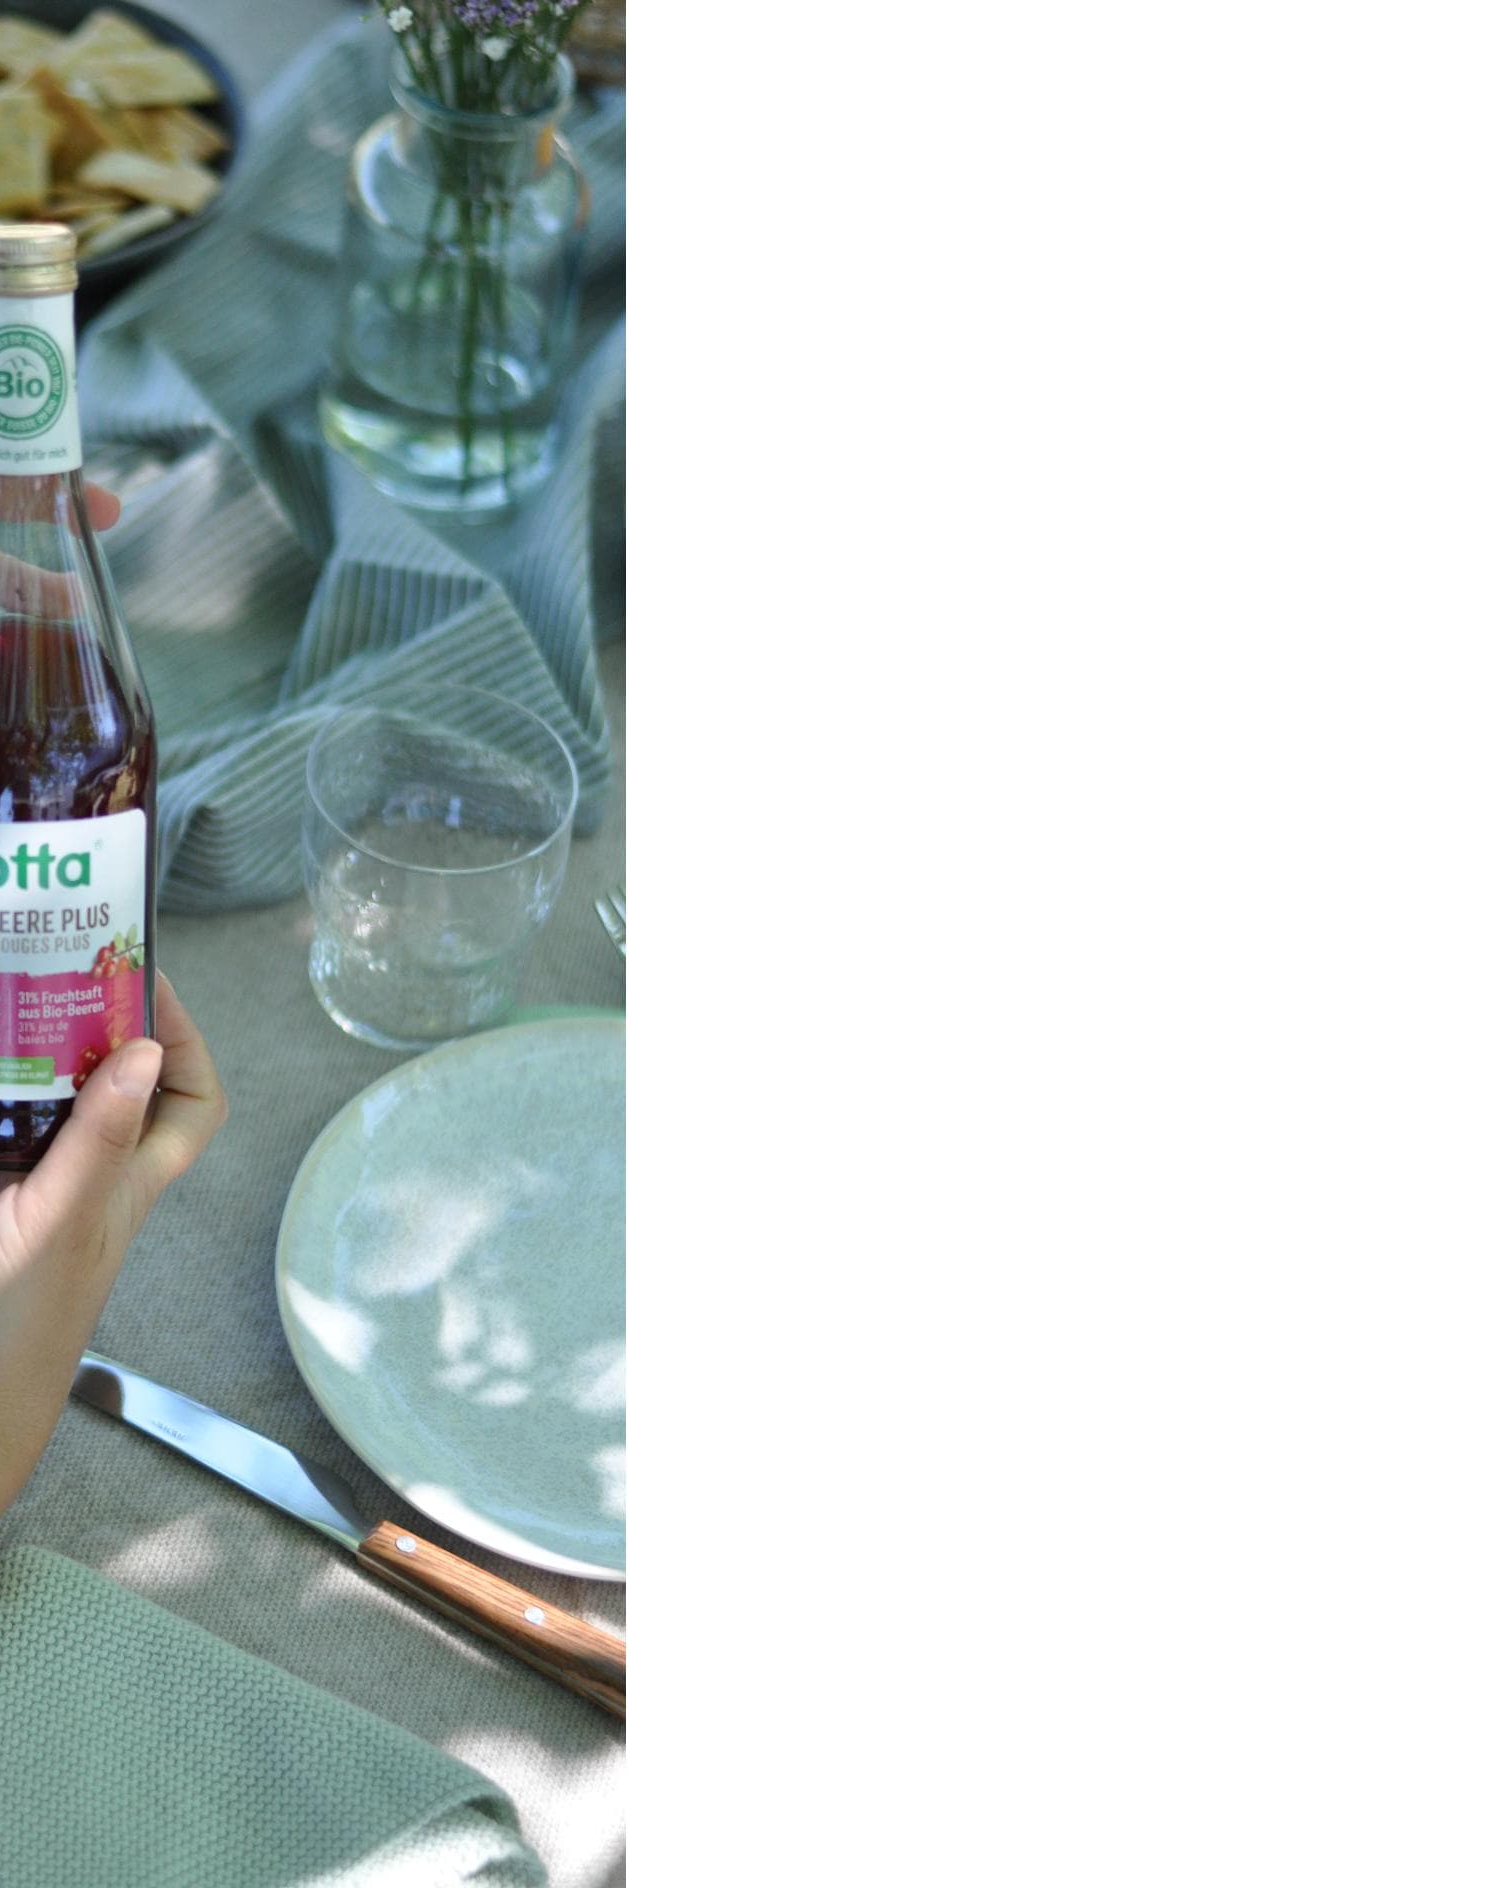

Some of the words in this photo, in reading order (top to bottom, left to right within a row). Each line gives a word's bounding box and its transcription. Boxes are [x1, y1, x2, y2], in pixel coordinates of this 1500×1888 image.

[62, 902, 110, 932] PLUS
[55, 933, 91, 953] PLUS
[18, 991, 39, 1005] 31%
[41, 985, 102, 1004] Fruchtsaft
[18, 1008, 40, 1019] aus
[43, 1001, 105, 1019] Bio-Beeren
[38, 1022, 53, 1034] jus
[56, 1021, 68, 1031] de
[48, 1033, 64, 1044] bio
